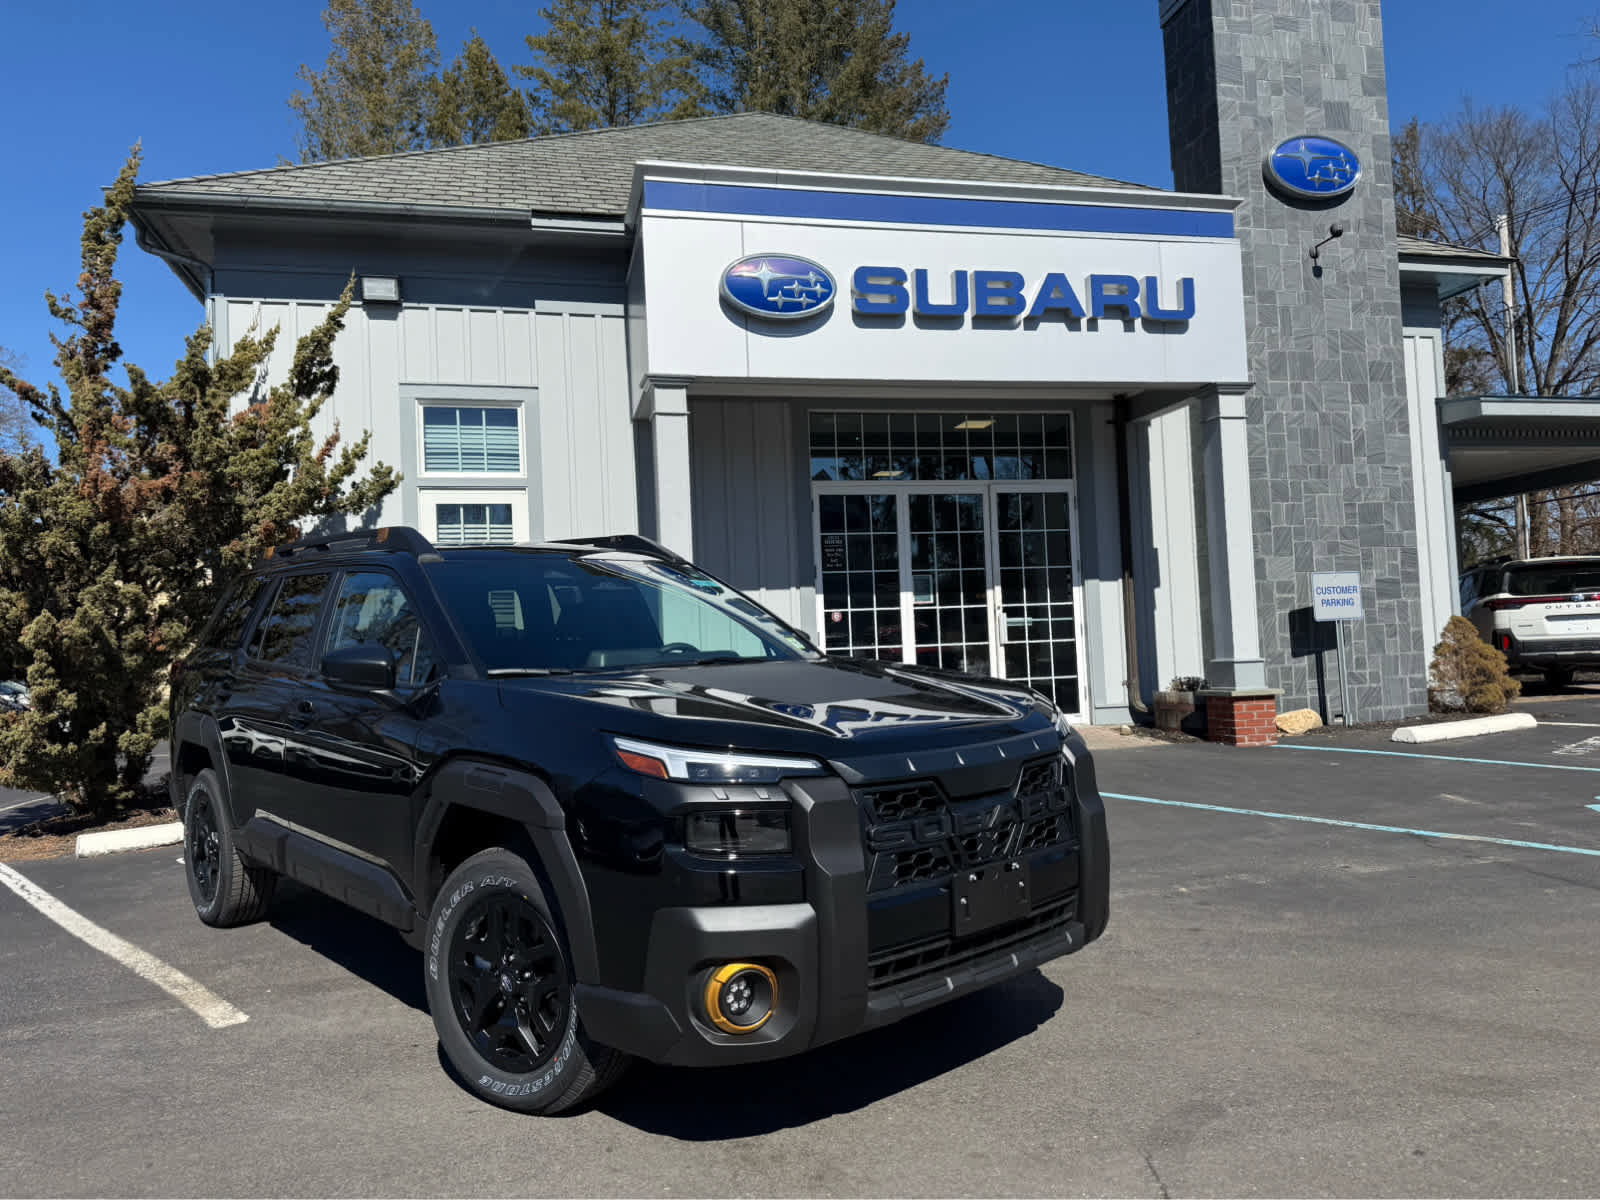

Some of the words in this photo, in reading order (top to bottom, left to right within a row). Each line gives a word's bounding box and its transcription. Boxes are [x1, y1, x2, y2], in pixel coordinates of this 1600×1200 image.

[852, 266, 1196, 320] SUBARU
[1316, 586, 1358, 595] CUSTOMER
[1321, 598, 1355, 607] PARKING
